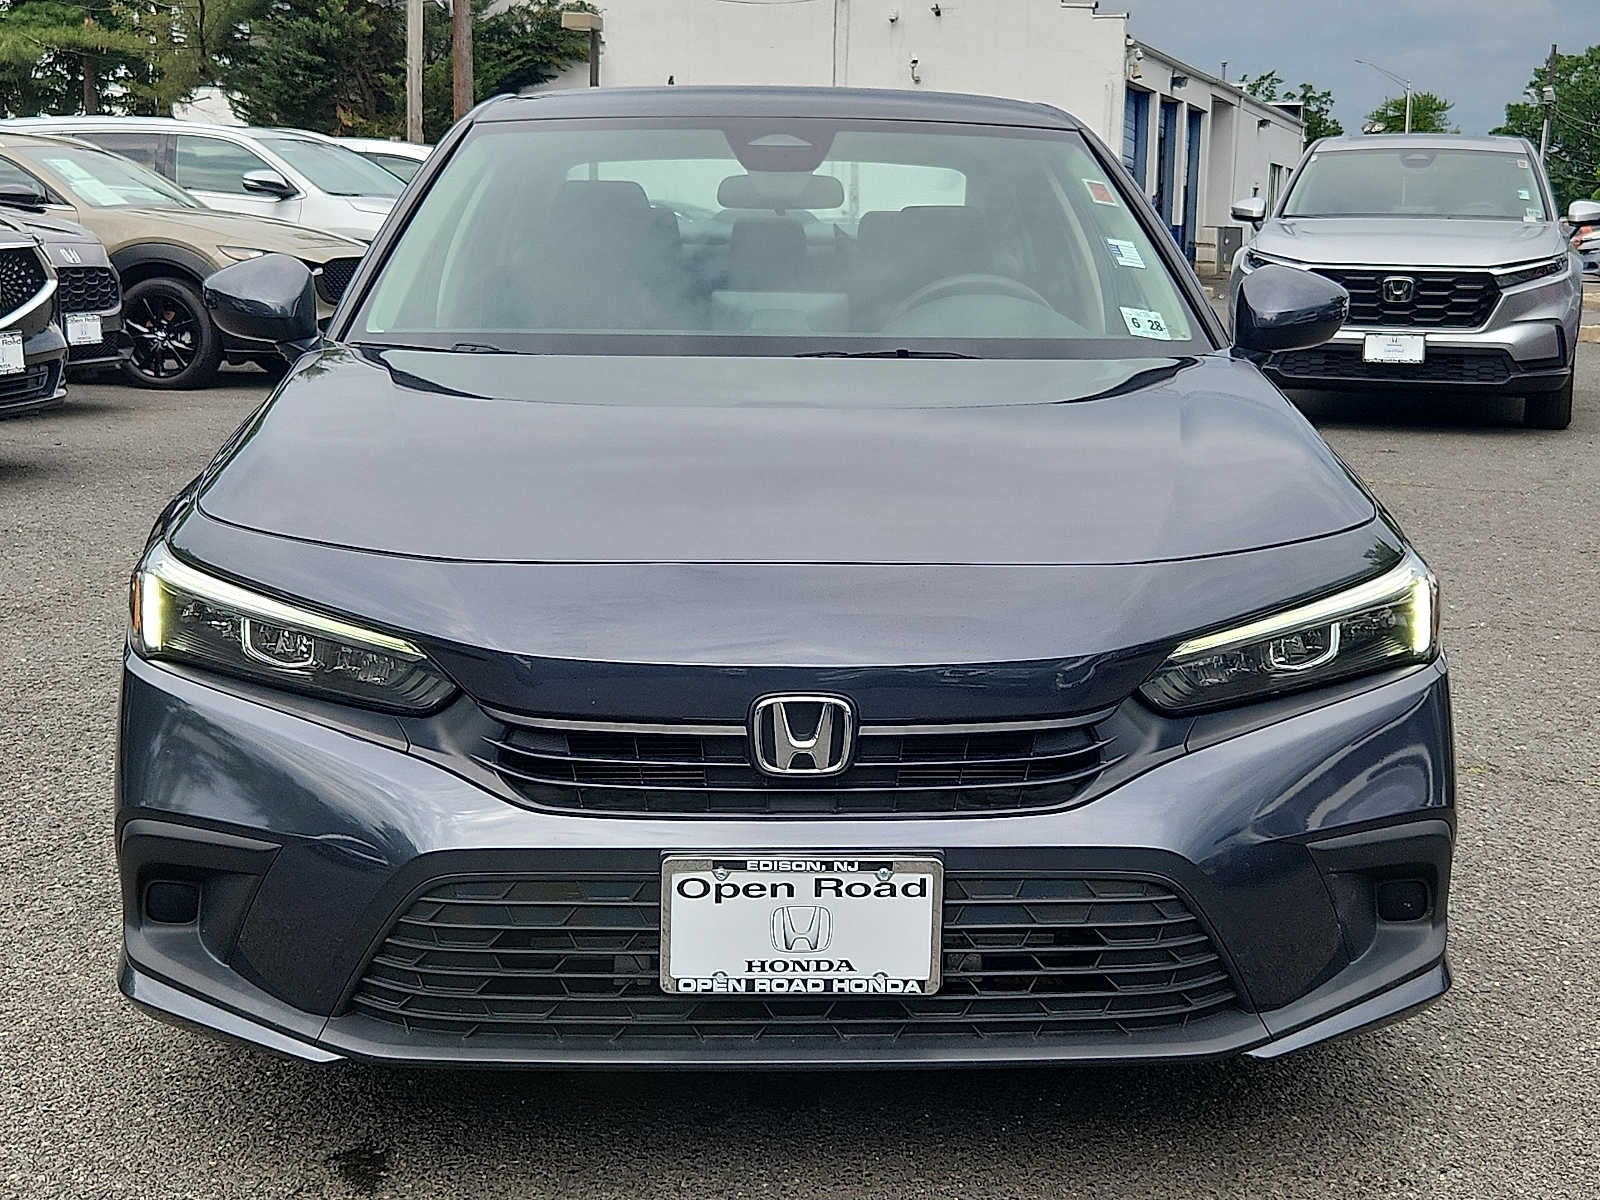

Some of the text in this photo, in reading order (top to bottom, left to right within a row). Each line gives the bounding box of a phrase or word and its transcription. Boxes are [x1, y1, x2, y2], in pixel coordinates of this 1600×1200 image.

[1131, 317, 1141, 328] 6
[746, 860, 860, 872] EDISON, NJ
[676, 877, 927, 904] Open Road
[744, 959, 857, 973] HONDA
[678, 978, 922, 993] OPEN ROAD HONDA
